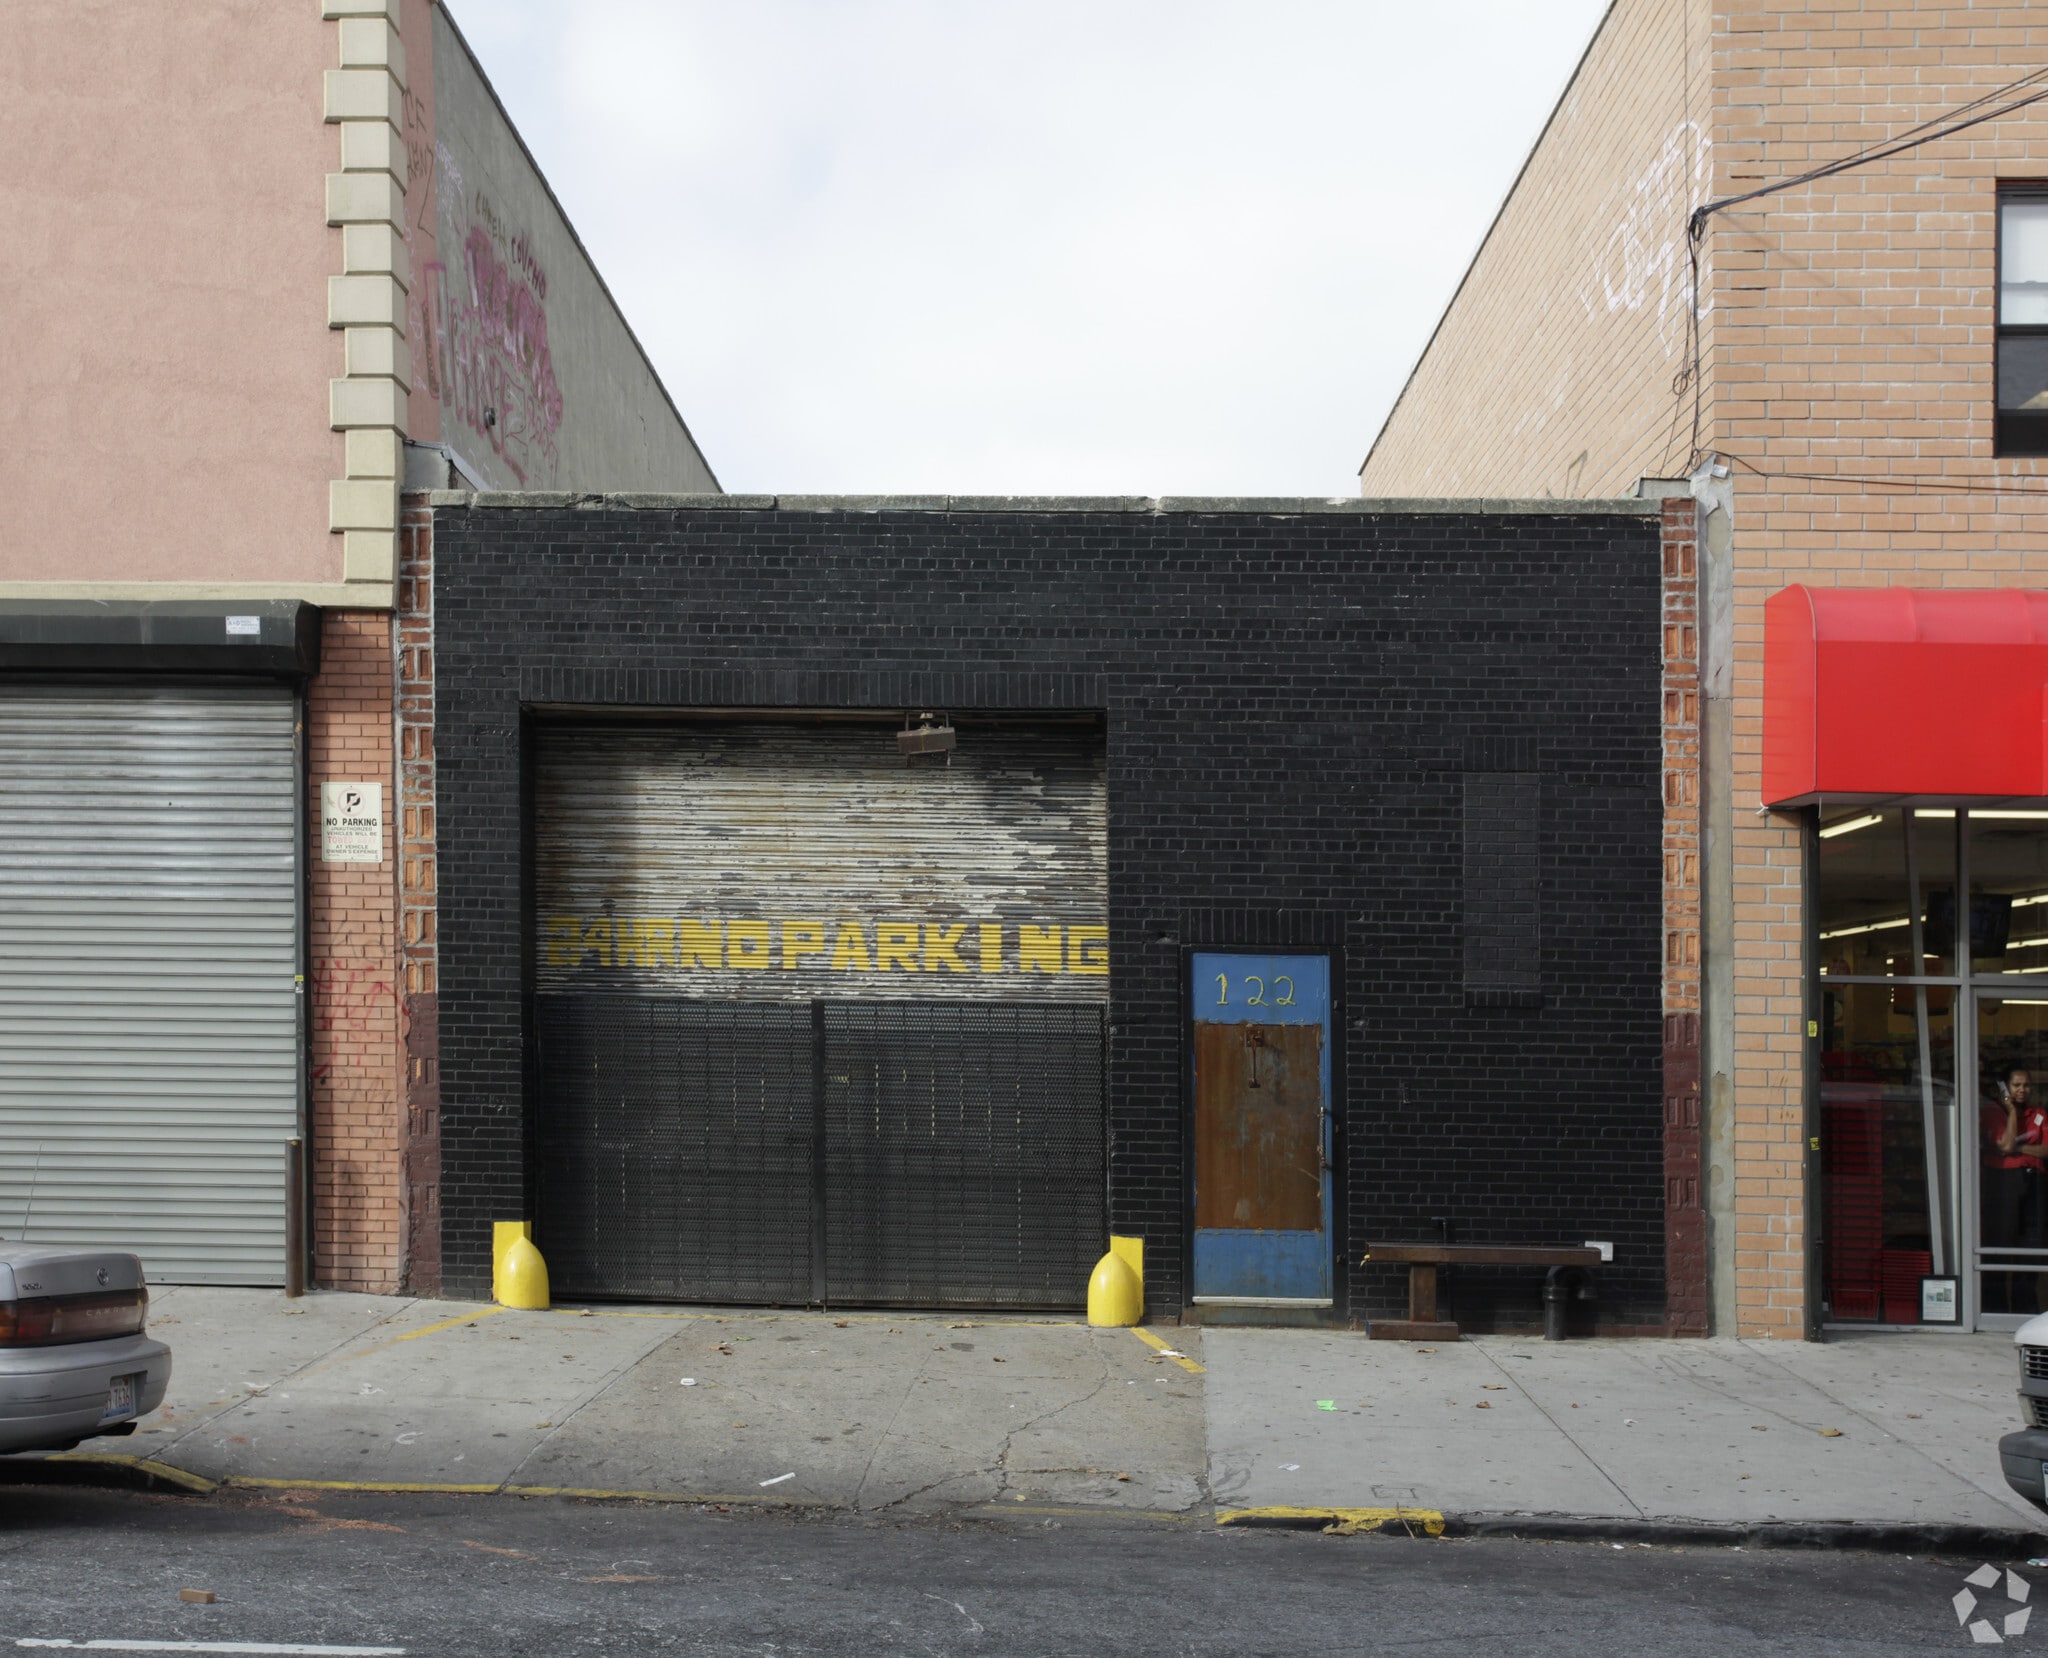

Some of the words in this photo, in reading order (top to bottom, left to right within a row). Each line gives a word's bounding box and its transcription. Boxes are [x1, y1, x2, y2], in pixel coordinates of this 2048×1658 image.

[326, 818, 338, 826] NO
[342, 818, 378, 826] PARKING
[783, 919, 1109, 975] PARKING
[1215, 973, 1297, 1007] 122
